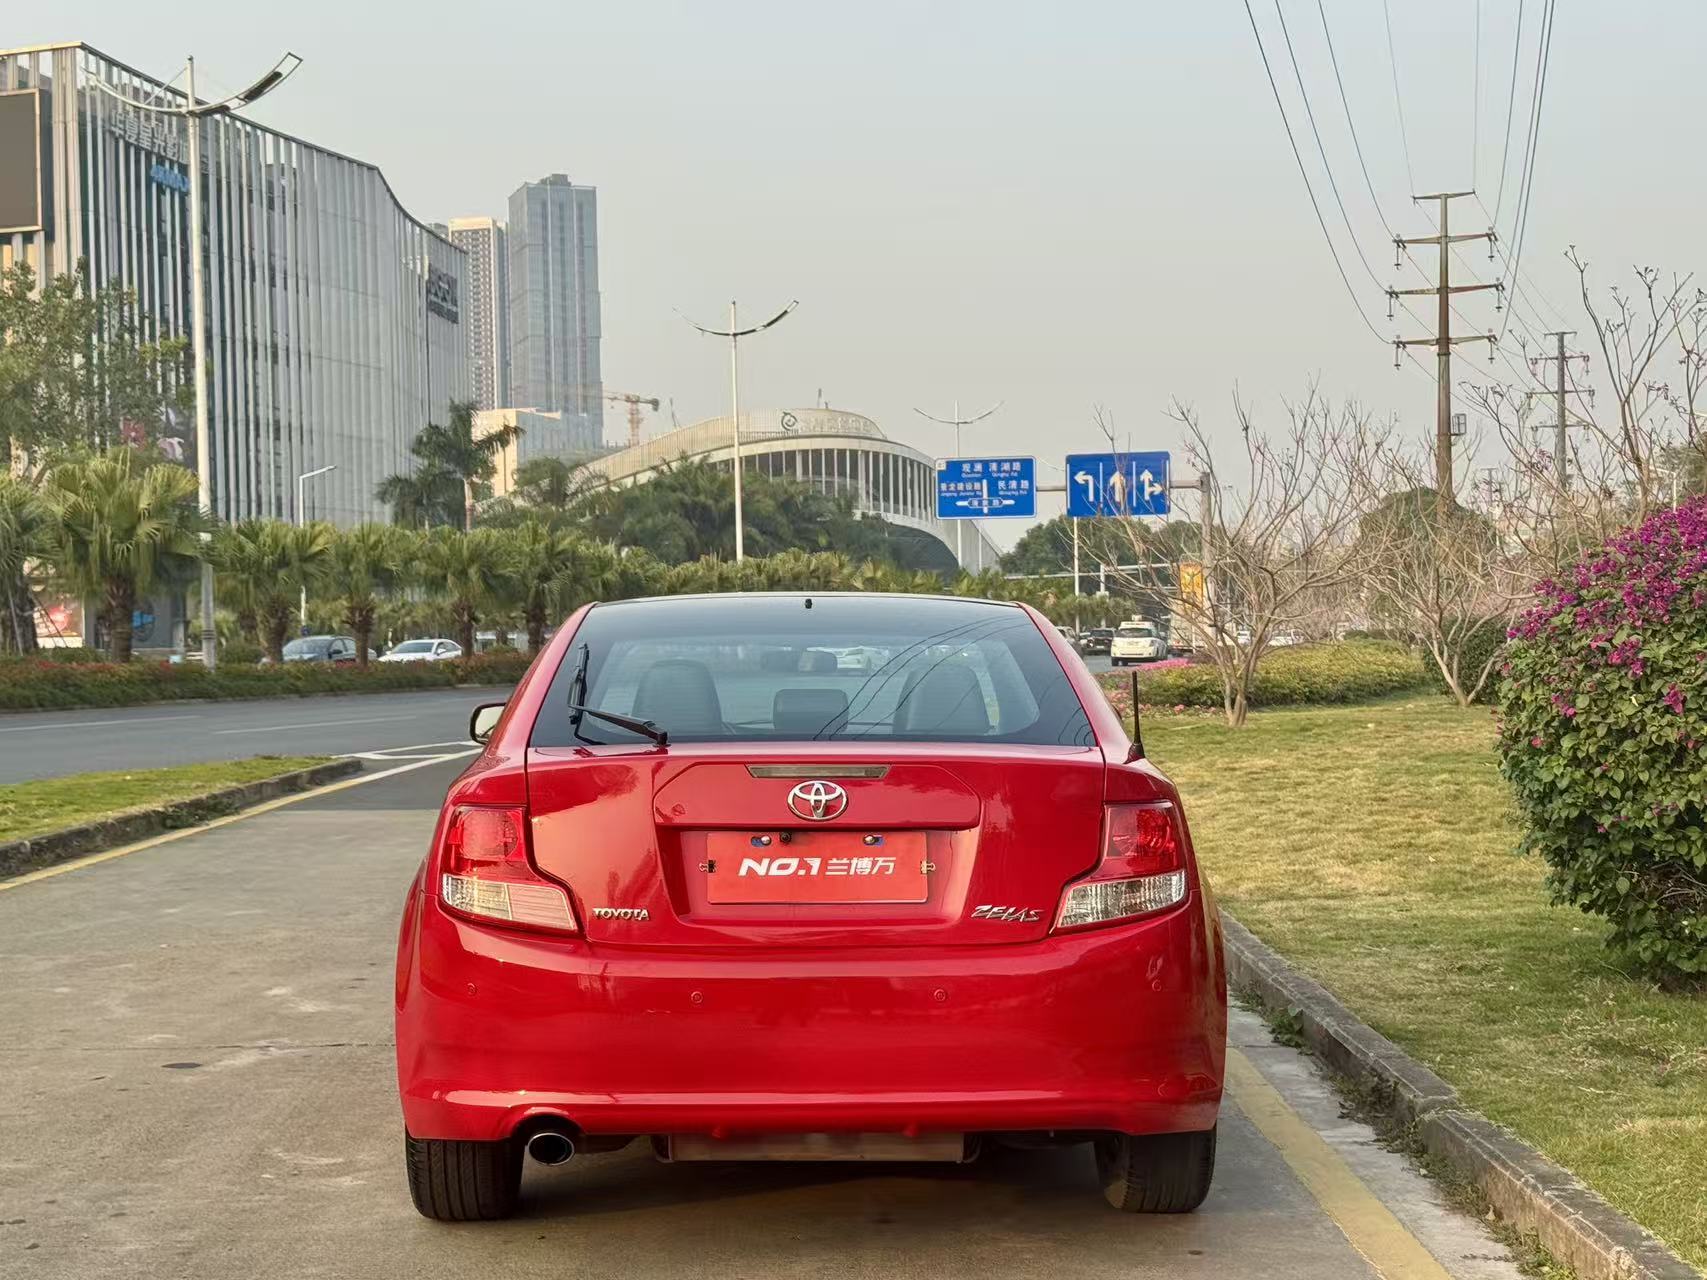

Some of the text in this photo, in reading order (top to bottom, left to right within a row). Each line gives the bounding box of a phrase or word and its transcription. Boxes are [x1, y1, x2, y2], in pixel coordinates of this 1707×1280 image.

[738, 857, 897, 876] NO.1 兰博万
[592, 907, 650, 920] TOYOTA
[971, 904, 1045, 922] ZELAS
